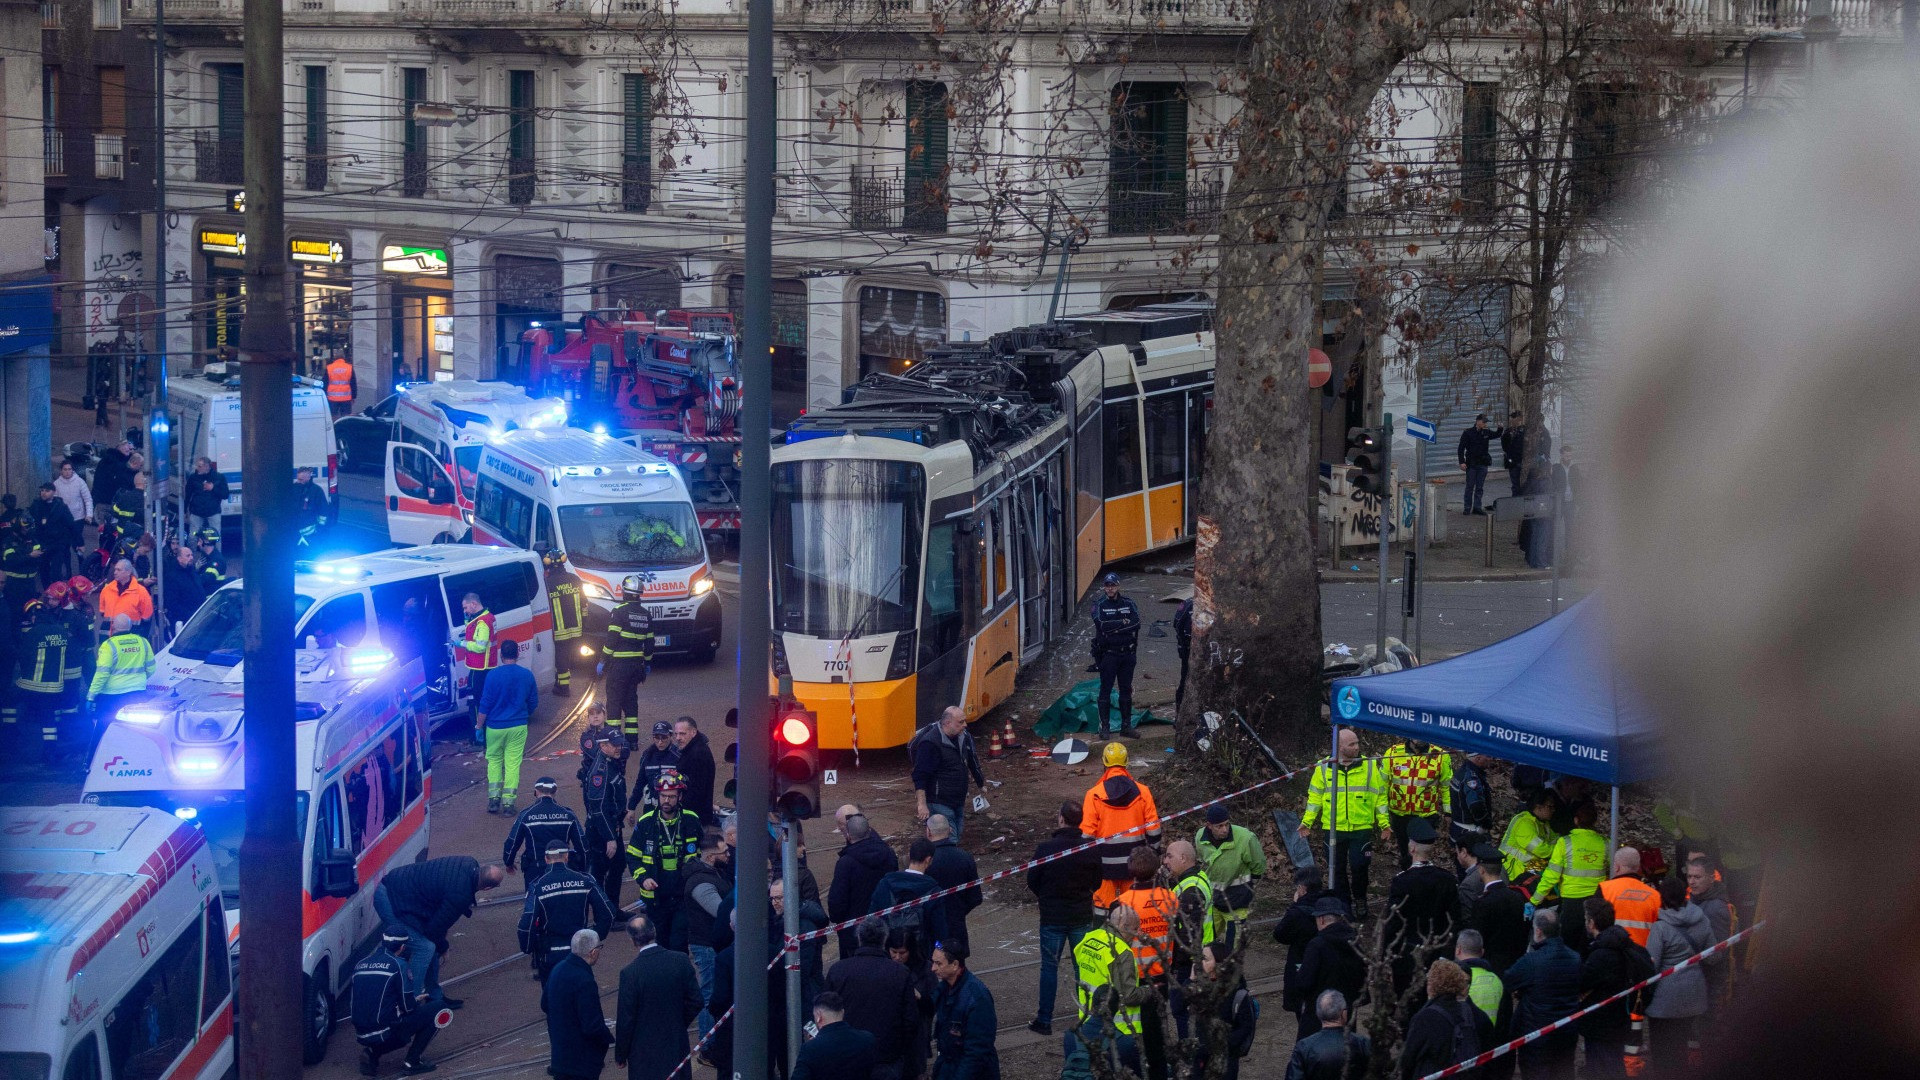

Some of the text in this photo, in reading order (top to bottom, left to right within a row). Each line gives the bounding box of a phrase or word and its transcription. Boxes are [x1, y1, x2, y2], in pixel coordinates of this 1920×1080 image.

[823, 660, 849, 671] 7707
[1368, 702, 1609, 762] COMUNE DI MILANO PROTEZIONE CIVILE
[116, 768, 153, 777] ANPAS
[826, 772, 835, 782] A
[975, 797, 982, 808] 2
[528, 813, 548, 821] POLIZIA
[541, 880, 585, 892] POLIZIA LOCALE
[369, 962, 391, 970] LOCALE
